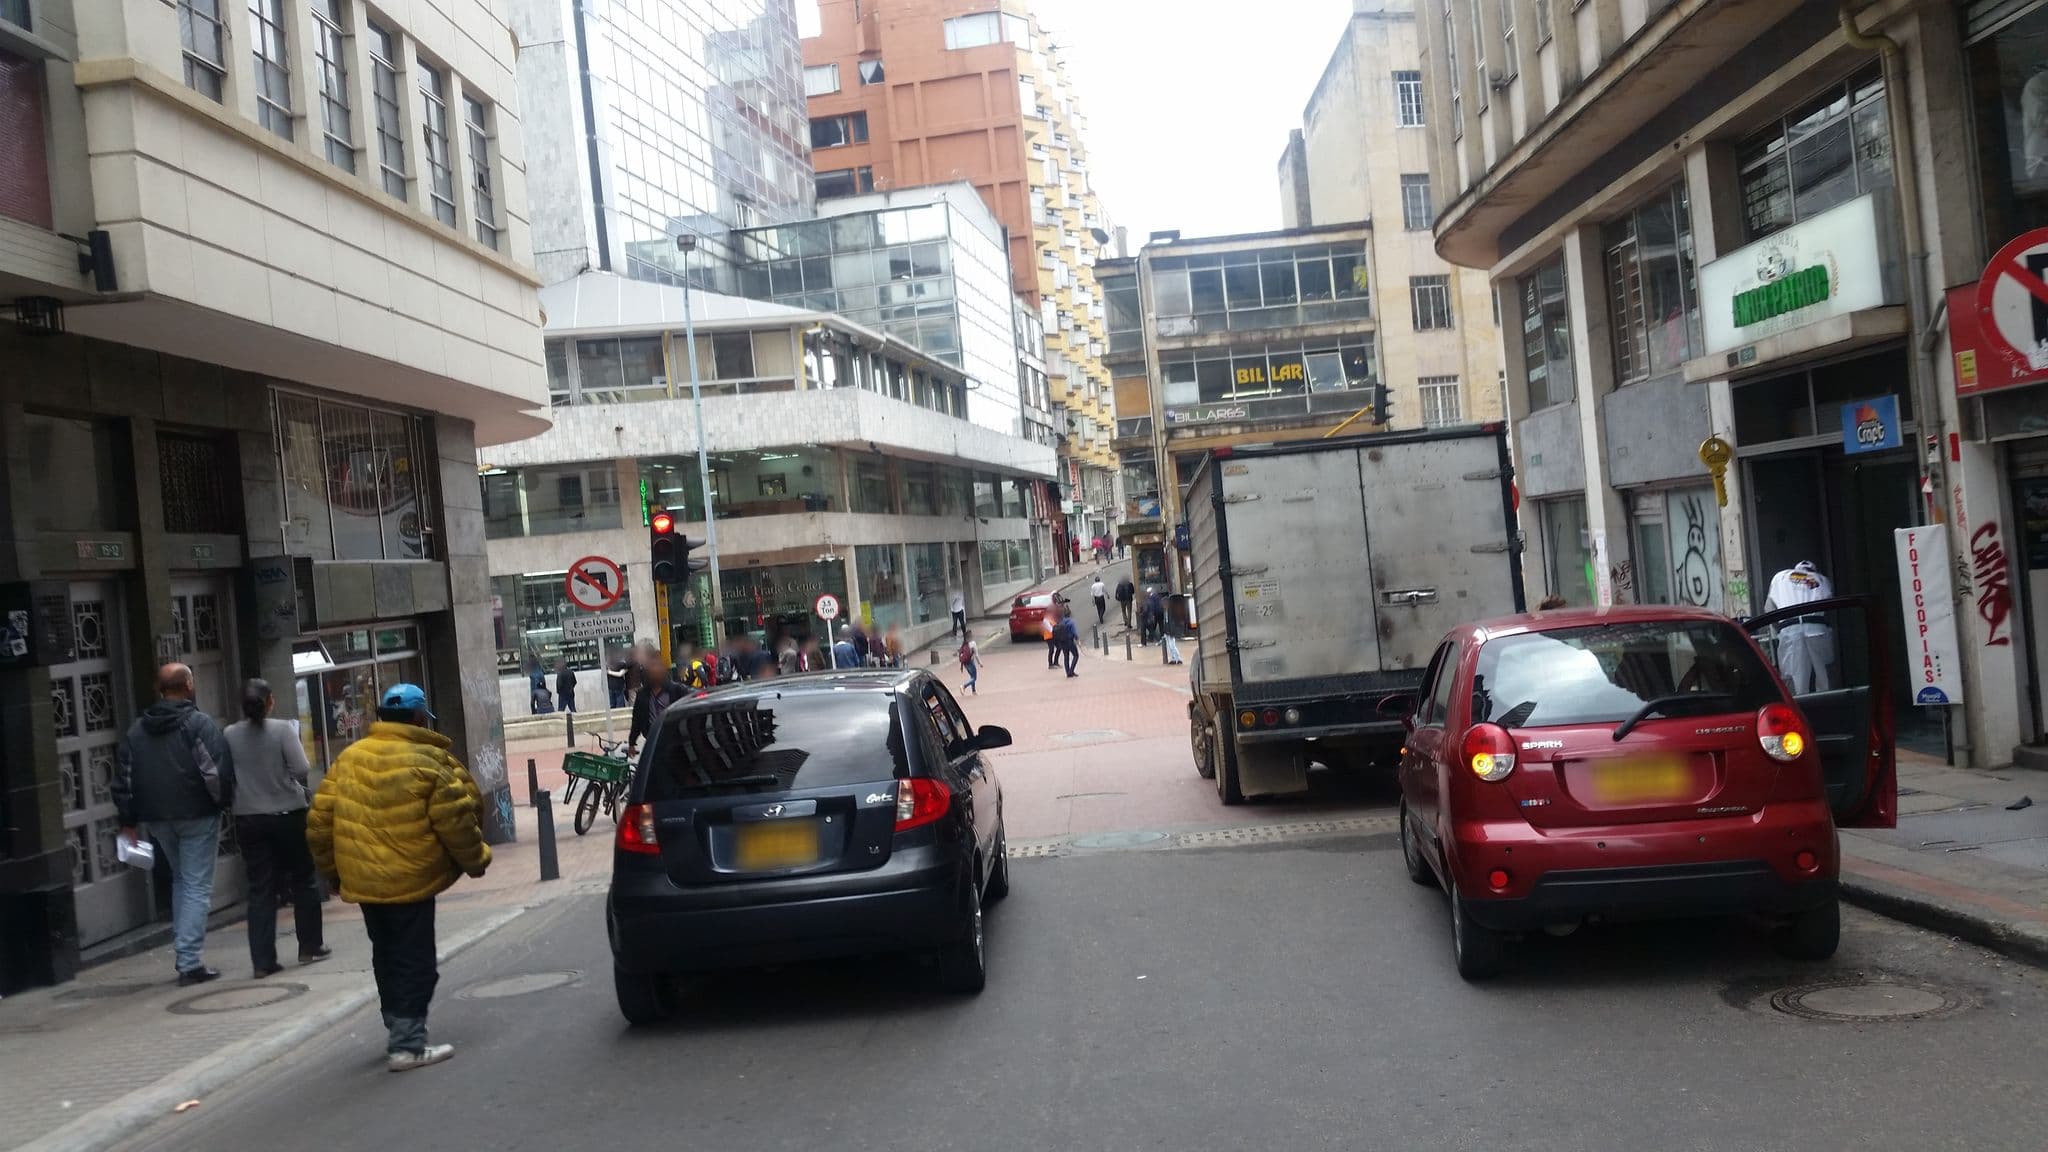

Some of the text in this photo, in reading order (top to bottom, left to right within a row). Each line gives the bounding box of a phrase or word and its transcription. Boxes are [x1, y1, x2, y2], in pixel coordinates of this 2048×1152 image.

[1174, 406, 1246, 423] BILLARES
[1908, 533, 1935, 683] FOTOCOPIAS
[573, 616, 624, 629] Exclusivo
[569, 624, 630, 638] Transmilenio
[1521, 740, 1564, 750] SPARK
